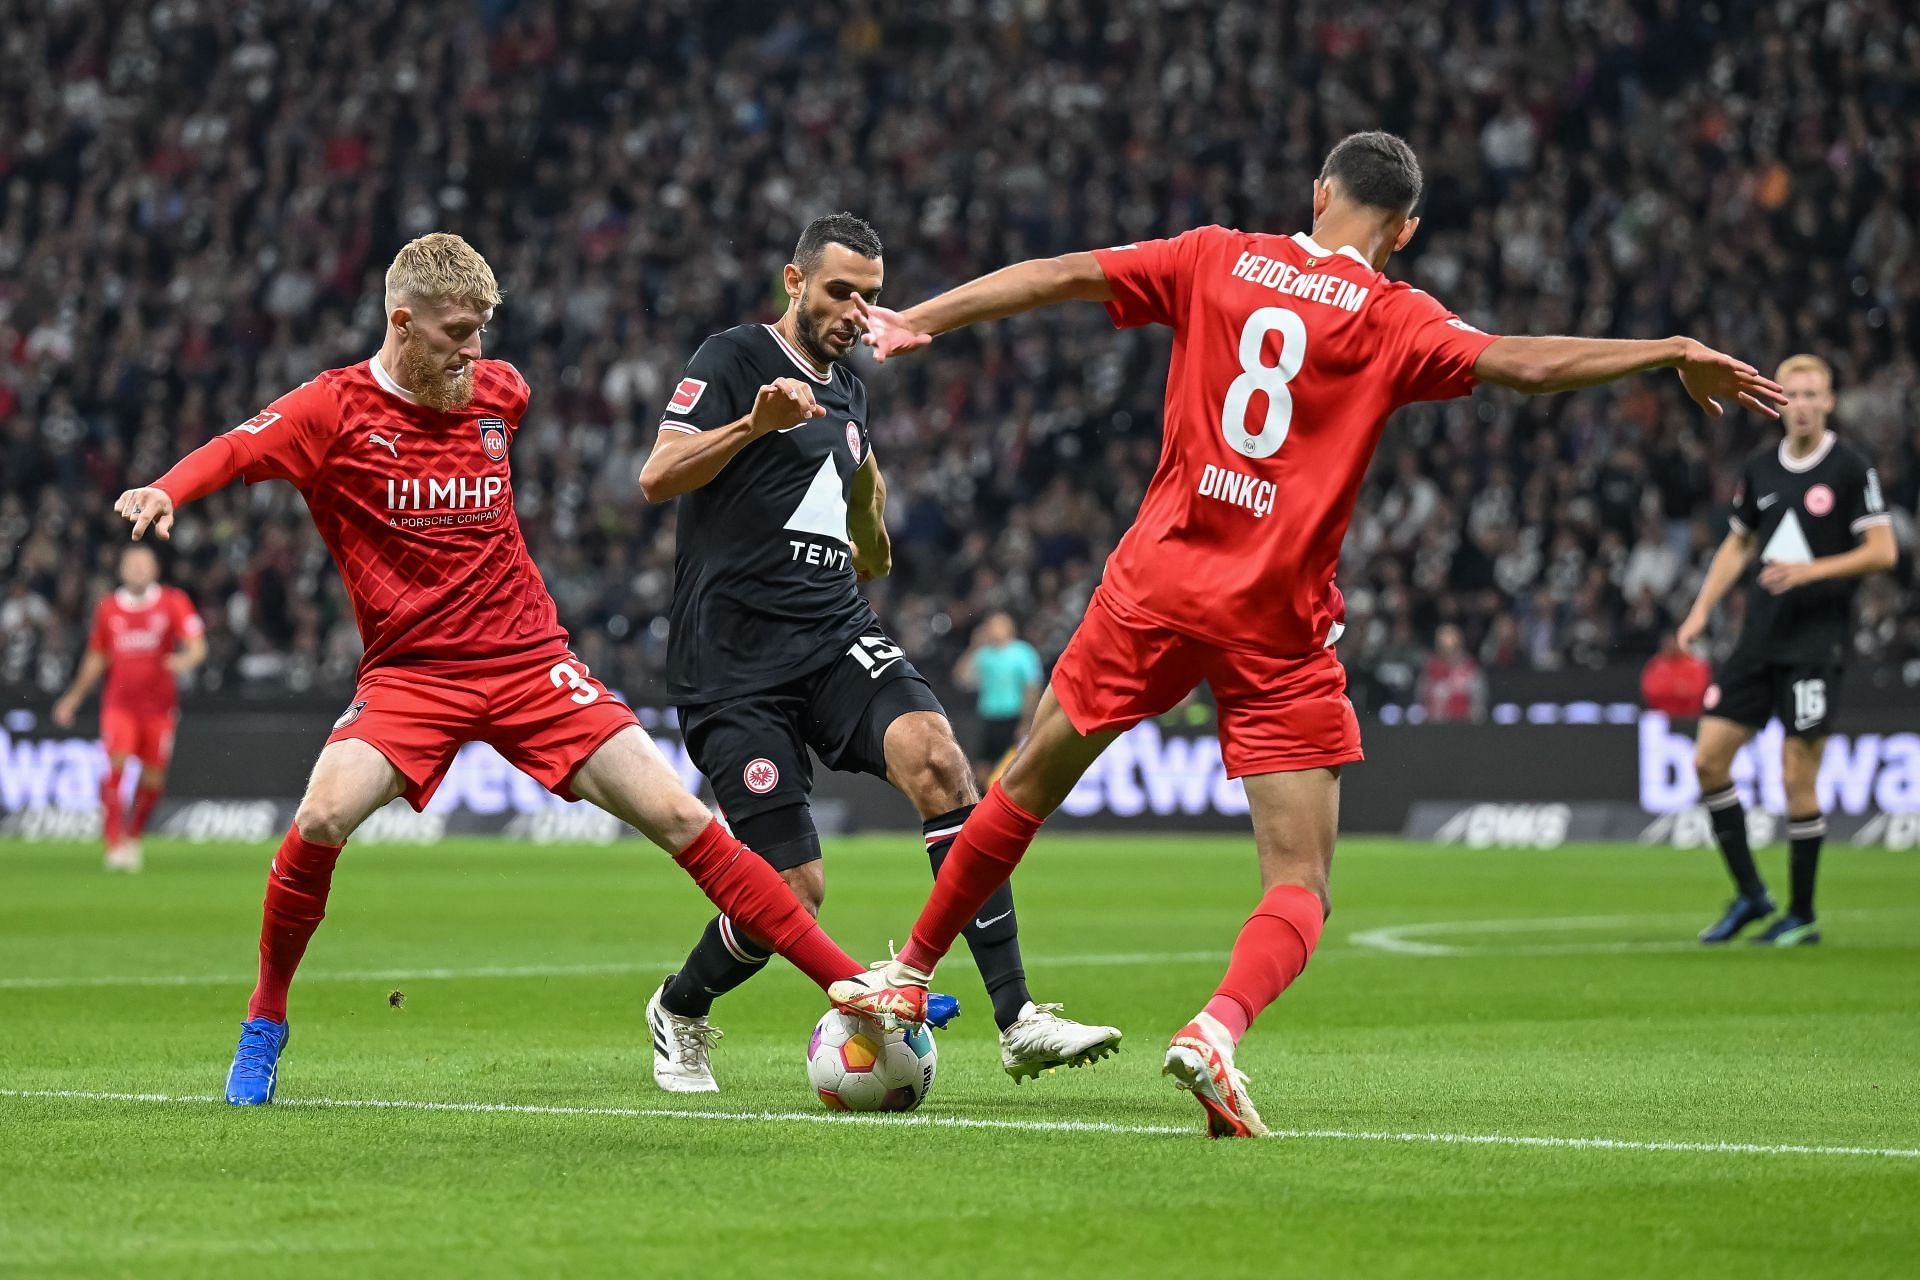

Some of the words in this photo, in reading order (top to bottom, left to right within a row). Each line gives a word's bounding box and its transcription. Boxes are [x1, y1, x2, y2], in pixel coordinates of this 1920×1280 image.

[1231, 251, 1369, 312] HEIDENHEIM
[1221, 306, 1307, 459] 8
[488, 438, 502, 450] FCH
[428, 476, 502, 509] MHP
[1198, 463, 1277, 518] DINKÇI
[389, 518, 397, 526] A
[401, 515, 454, 527] PORSCHE
[789, 540, 848, 571] TENT
[845, 636, 904, 671] 15
[549, 662, 599, 705] 3
[1793, 678, 1826, 719] 16
[1465, 803, 1572, 848] DWS
